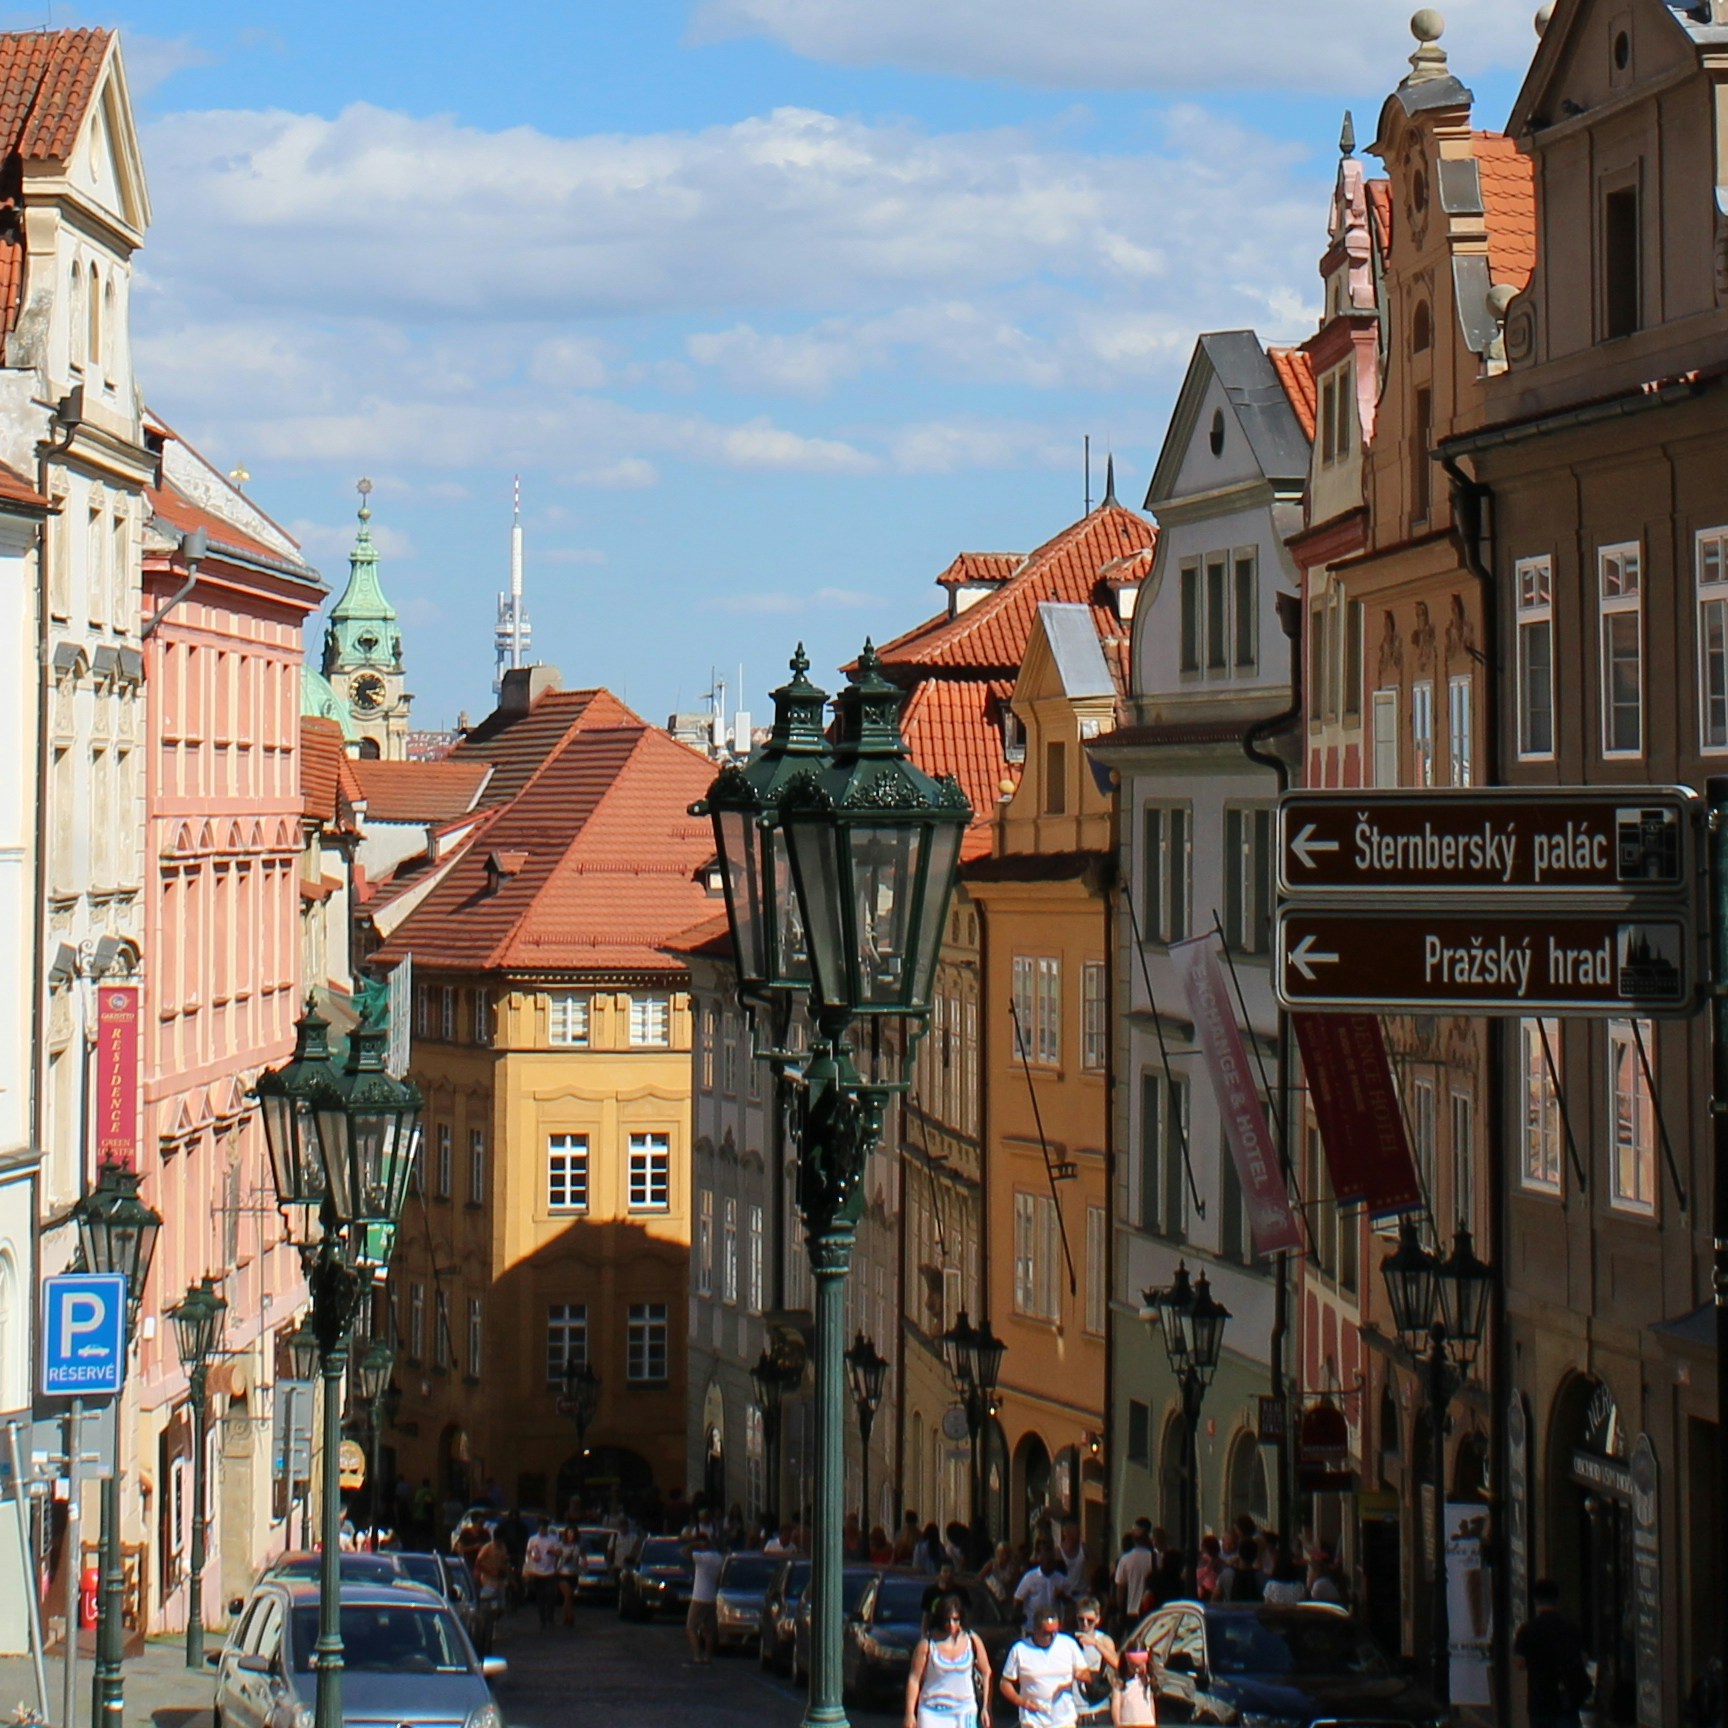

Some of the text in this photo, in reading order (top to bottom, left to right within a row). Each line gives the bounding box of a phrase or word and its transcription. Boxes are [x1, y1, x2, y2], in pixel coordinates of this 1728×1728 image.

[1354, 811, 1608, 881] Šternberský palác
[1424, 934, 1612, 994] Pražský hrad
[110, 1027, 122, 1134] RESIDENCE
[1191, 964, 1270, 1189] EXCHANGE & HOTEL
[1368, 1088, 1400, 1157] HOTEL
[61, 1292, 105, 1359] P
[49, 1363, 114, 1381] RÉSERVÉ
